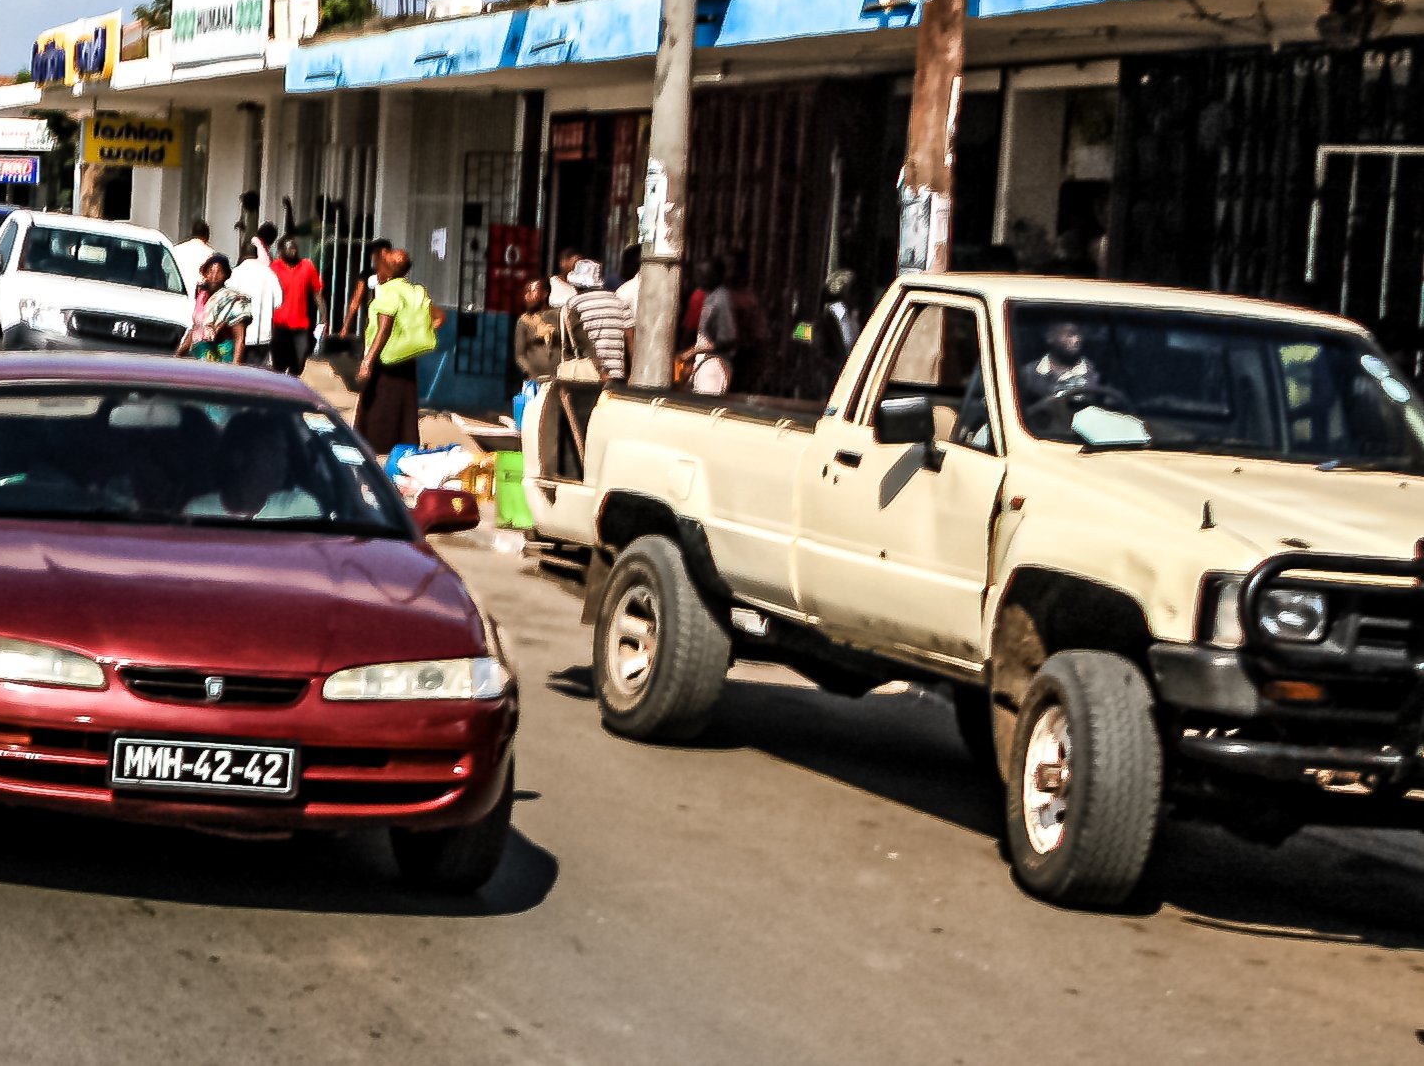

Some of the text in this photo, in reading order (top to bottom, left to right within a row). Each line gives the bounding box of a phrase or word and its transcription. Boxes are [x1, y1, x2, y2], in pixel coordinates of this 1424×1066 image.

[196, 4, 234, 35] HUMANA
[94, 120, 174, 142] fashion
[99, 144, 165, 164] world
[123, 745, 284, 786] MMH-42-42
